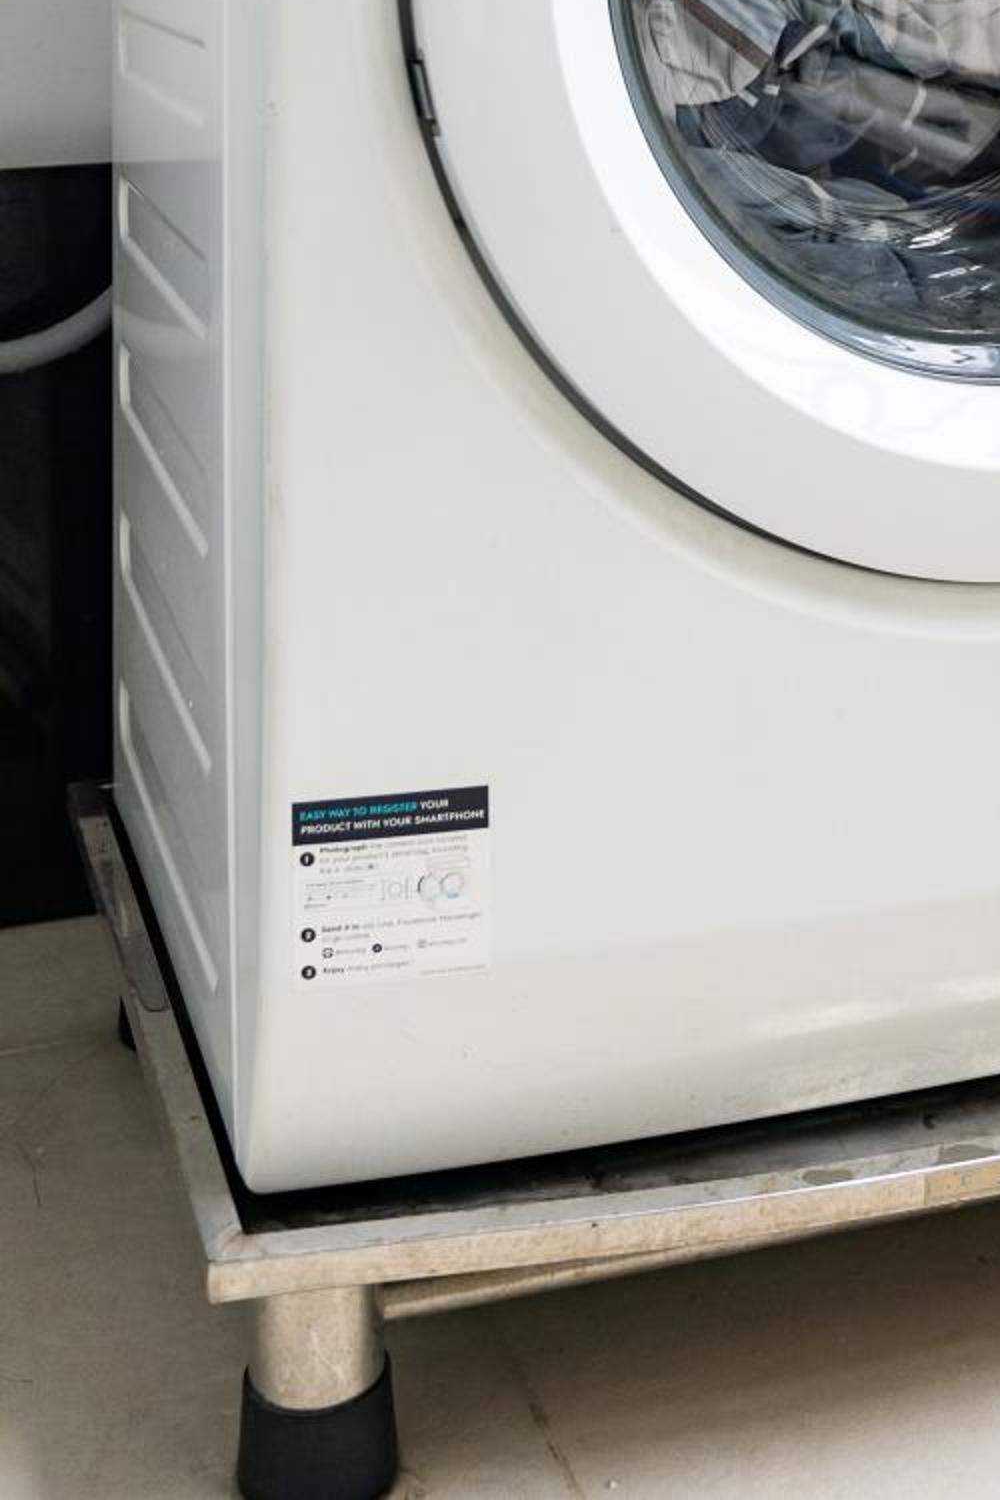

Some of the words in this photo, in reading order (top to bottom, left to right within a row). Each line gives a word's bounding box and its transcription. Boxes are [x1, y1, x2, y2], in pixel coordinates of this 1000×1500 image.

[300, 810, 325, 821] EASY
[328, 808, 351, 818] WAY
[352, 807, 367, 817] TO
[369, 802, 417, 815] REGISTER
[419, 798, 449, 810] YOUR
[301, 820, 352, 835] PRODUCT
[353, 819, 381, 830] WITH
[383, 816, 412, 828] YOUR
[414, 809, 485, 825] SMARTPHONE
